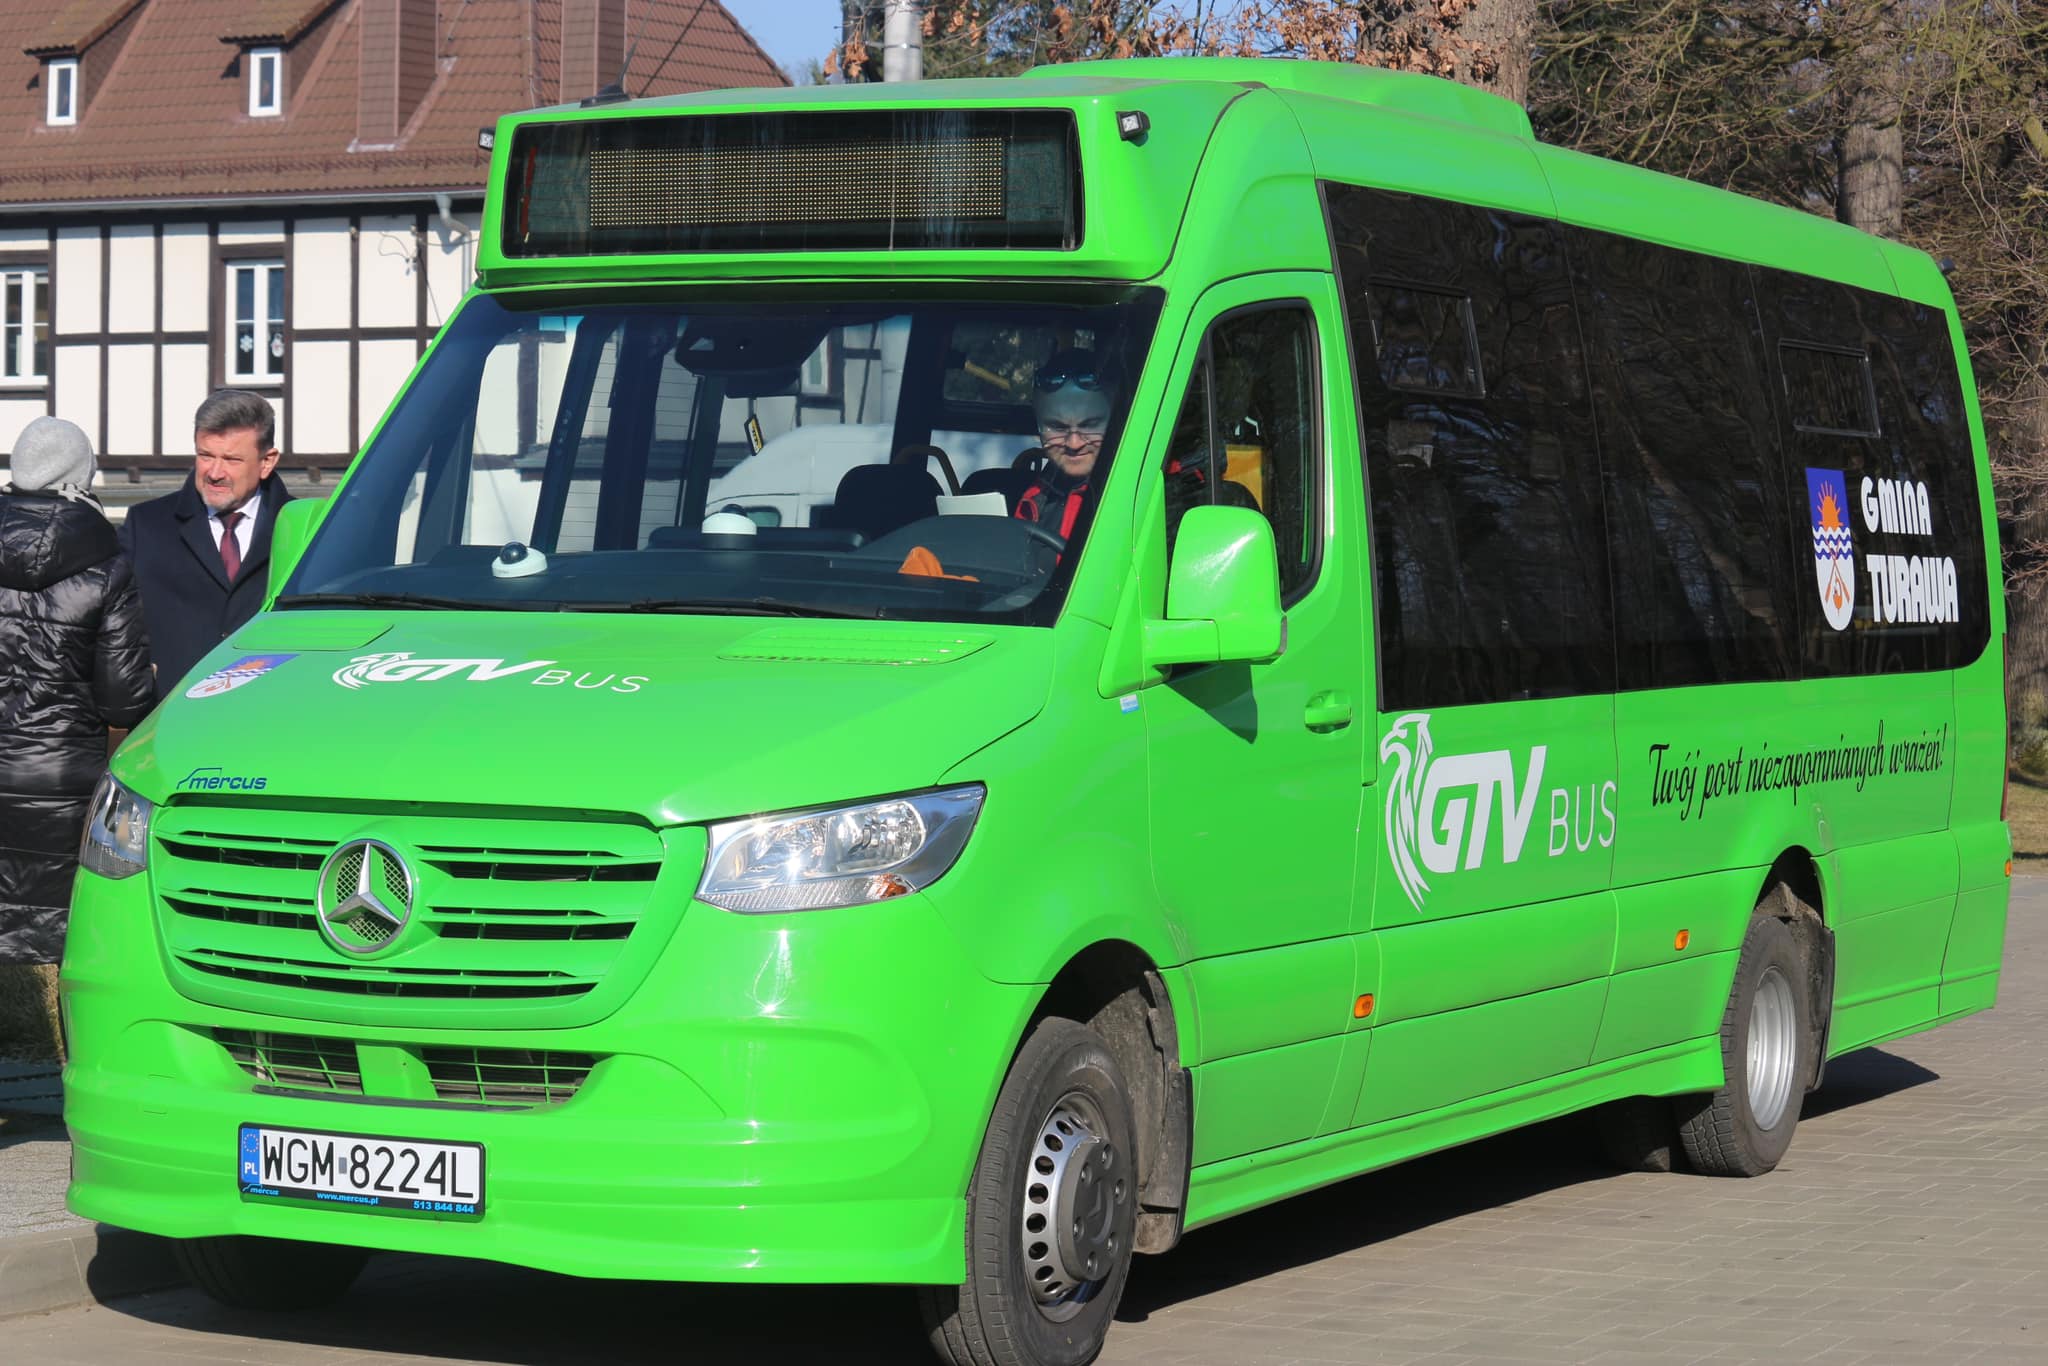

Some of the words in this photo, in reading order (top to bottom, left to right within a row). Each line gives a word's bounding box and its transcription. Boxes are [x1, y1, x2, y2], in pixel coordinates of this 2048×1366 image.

[1861, 476, 1932, 535] GMINA
[1866, 554, 1959, 623] TURAWA
[366, 658, 558, 682] GTV
[531, 669, 650, 693] BUS
[188, 776, 267, 790] mercus
[1649, 743, 1701, 821] Twój
[1698, 746, 1744, 820] port
[1745, 719, 1885, 806] niezapomnianych
[1889, 722, 1948, 775] wrażeń!
[1418, 745, 1547, 874] GTV
[1548, 780, 1617, 856] BUS
[244, 1162, 258, 1175] PL
[263, 1135, 334, 1186] WGM
[350, 1144, 474, 1199] 8224L
[250, 1187, 279, 1196] mercus
[316, 1191, 379, 1206] www.mercus.pl
[413, 1200, 432, 1210] 513
[434, 1202, 453, 1212] 844
[455, 1204, 475, 1214] 844
